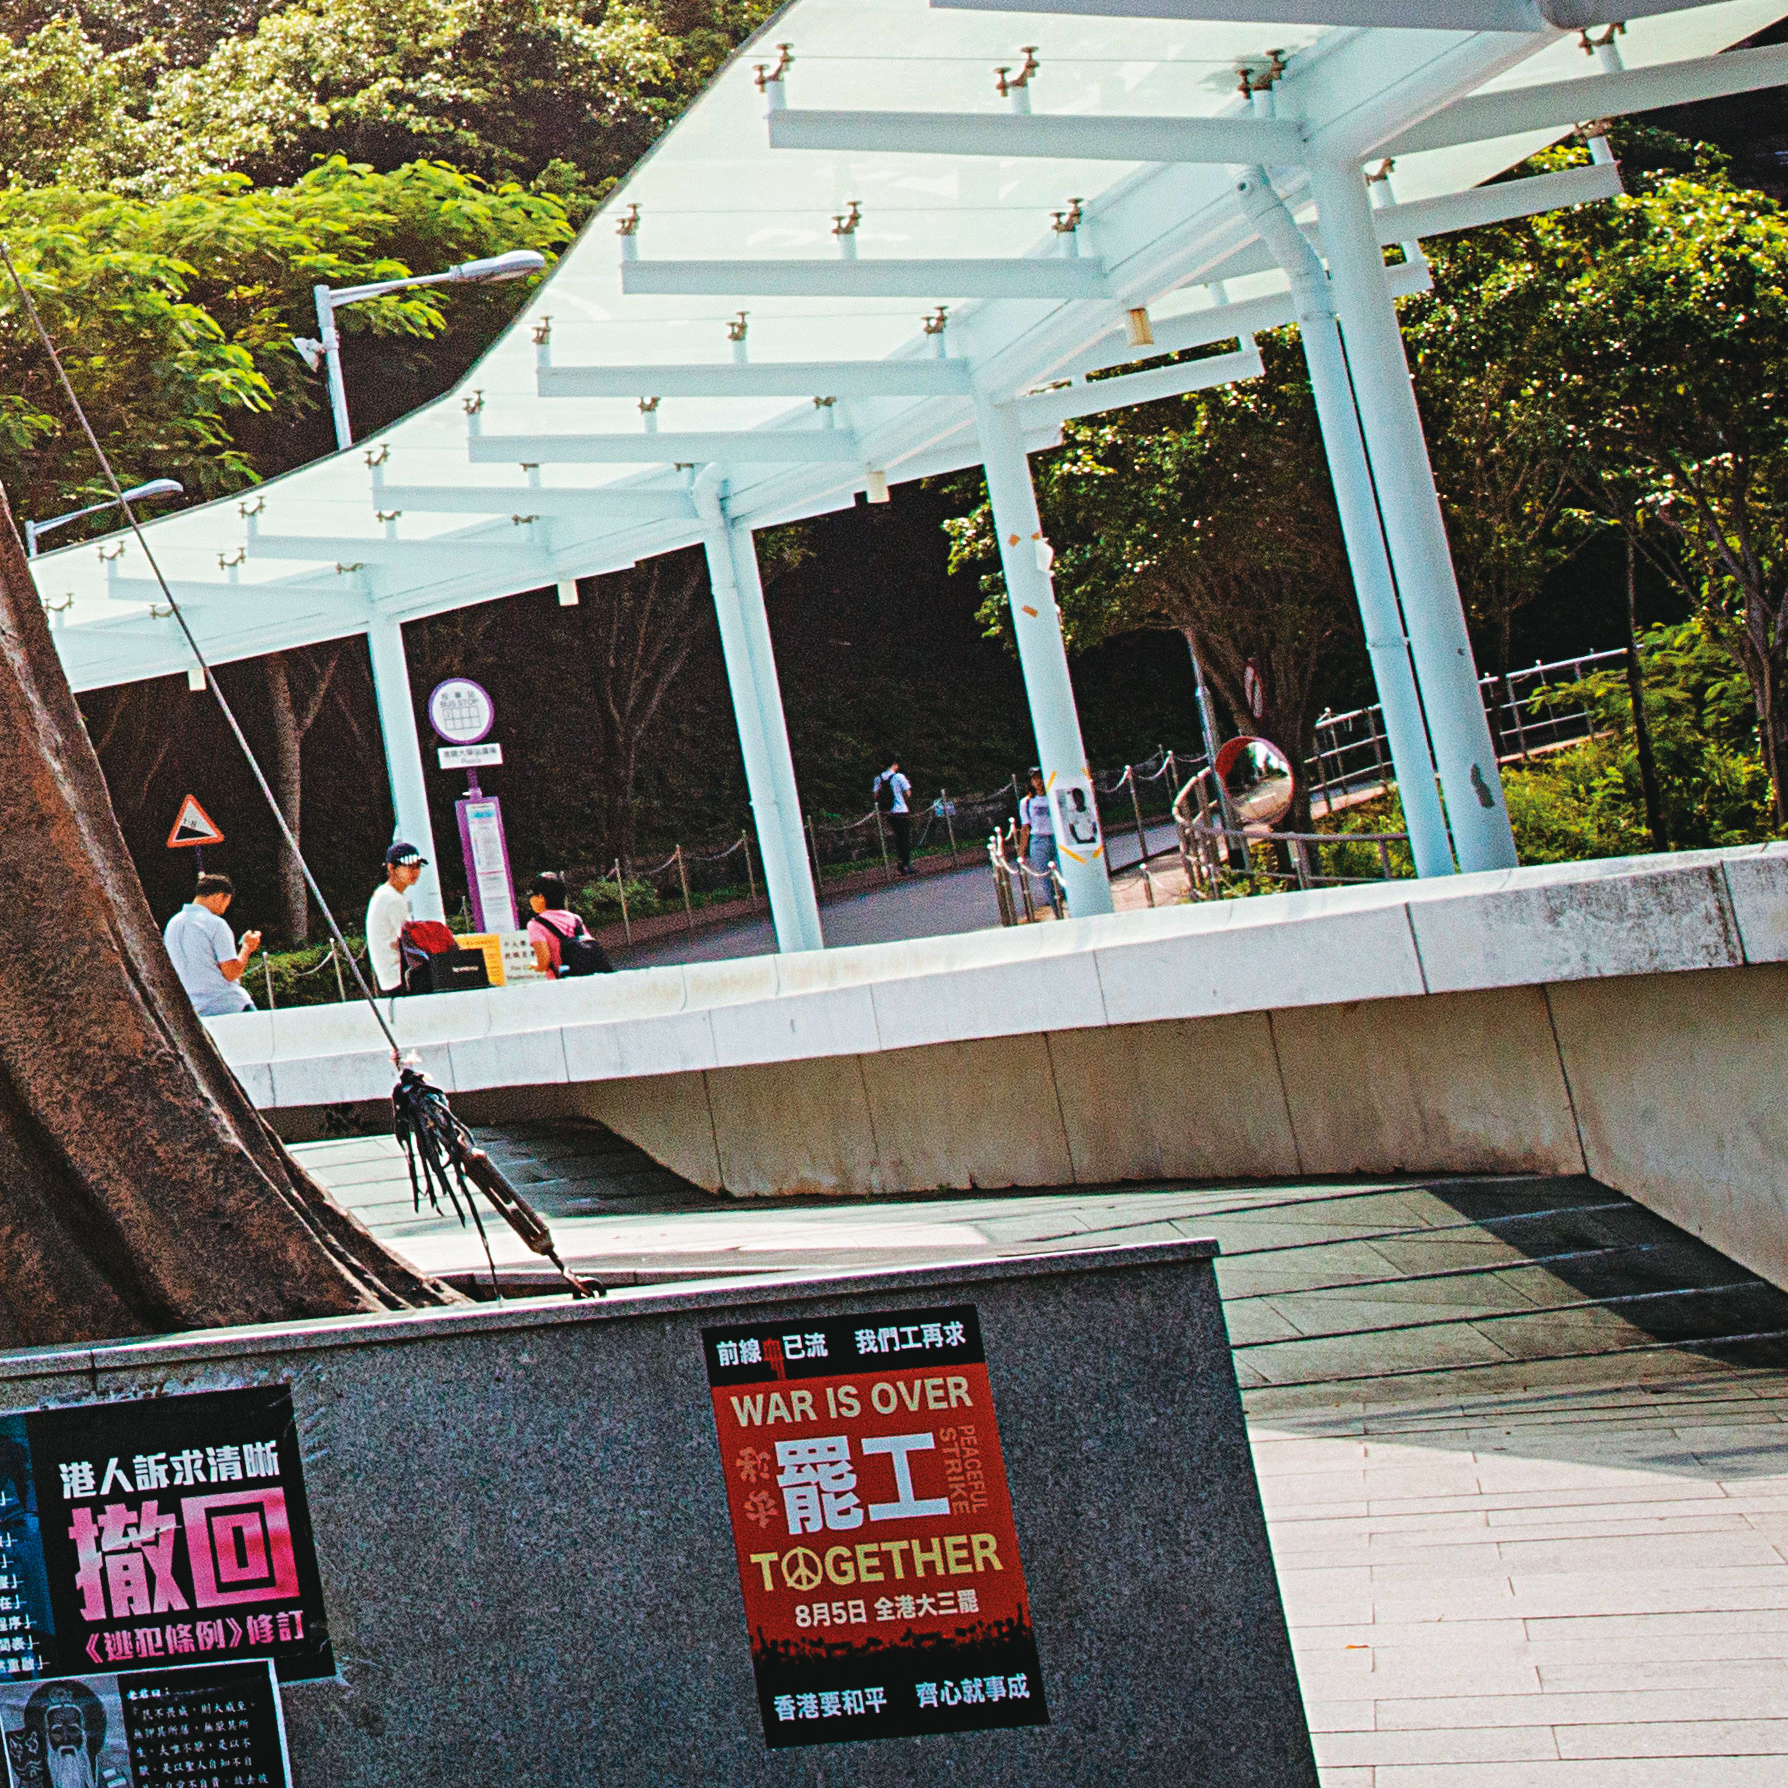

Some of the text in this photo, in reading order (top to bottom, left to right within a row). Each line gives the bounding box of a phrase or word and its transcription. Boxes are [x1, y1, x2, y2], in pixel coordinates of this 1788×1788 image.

[854, 1321, 966, 1355] 我們工再求
[730, 1376, 974, 1427] WAR IS OVER
[58, 1440, 281, 1500] 港人訴求清晰
[774, 1432, 952, 1535] 罷工
[939, 1426, 971, 1517] STRIKE
[958, 1424, 989, 1514] PEACEFUL
[68, 1486, 301, 1622] 撤回
[749, 1532, 1004, 1592] TOGETHER
[85, 1610, 305, 1664] 《逃犯條例》修訂
[794, 1589, 979, 1628] 8月5日 全港大三罷
[774, 1673, 1031, 1722] 香港要和平 齊心就事成
